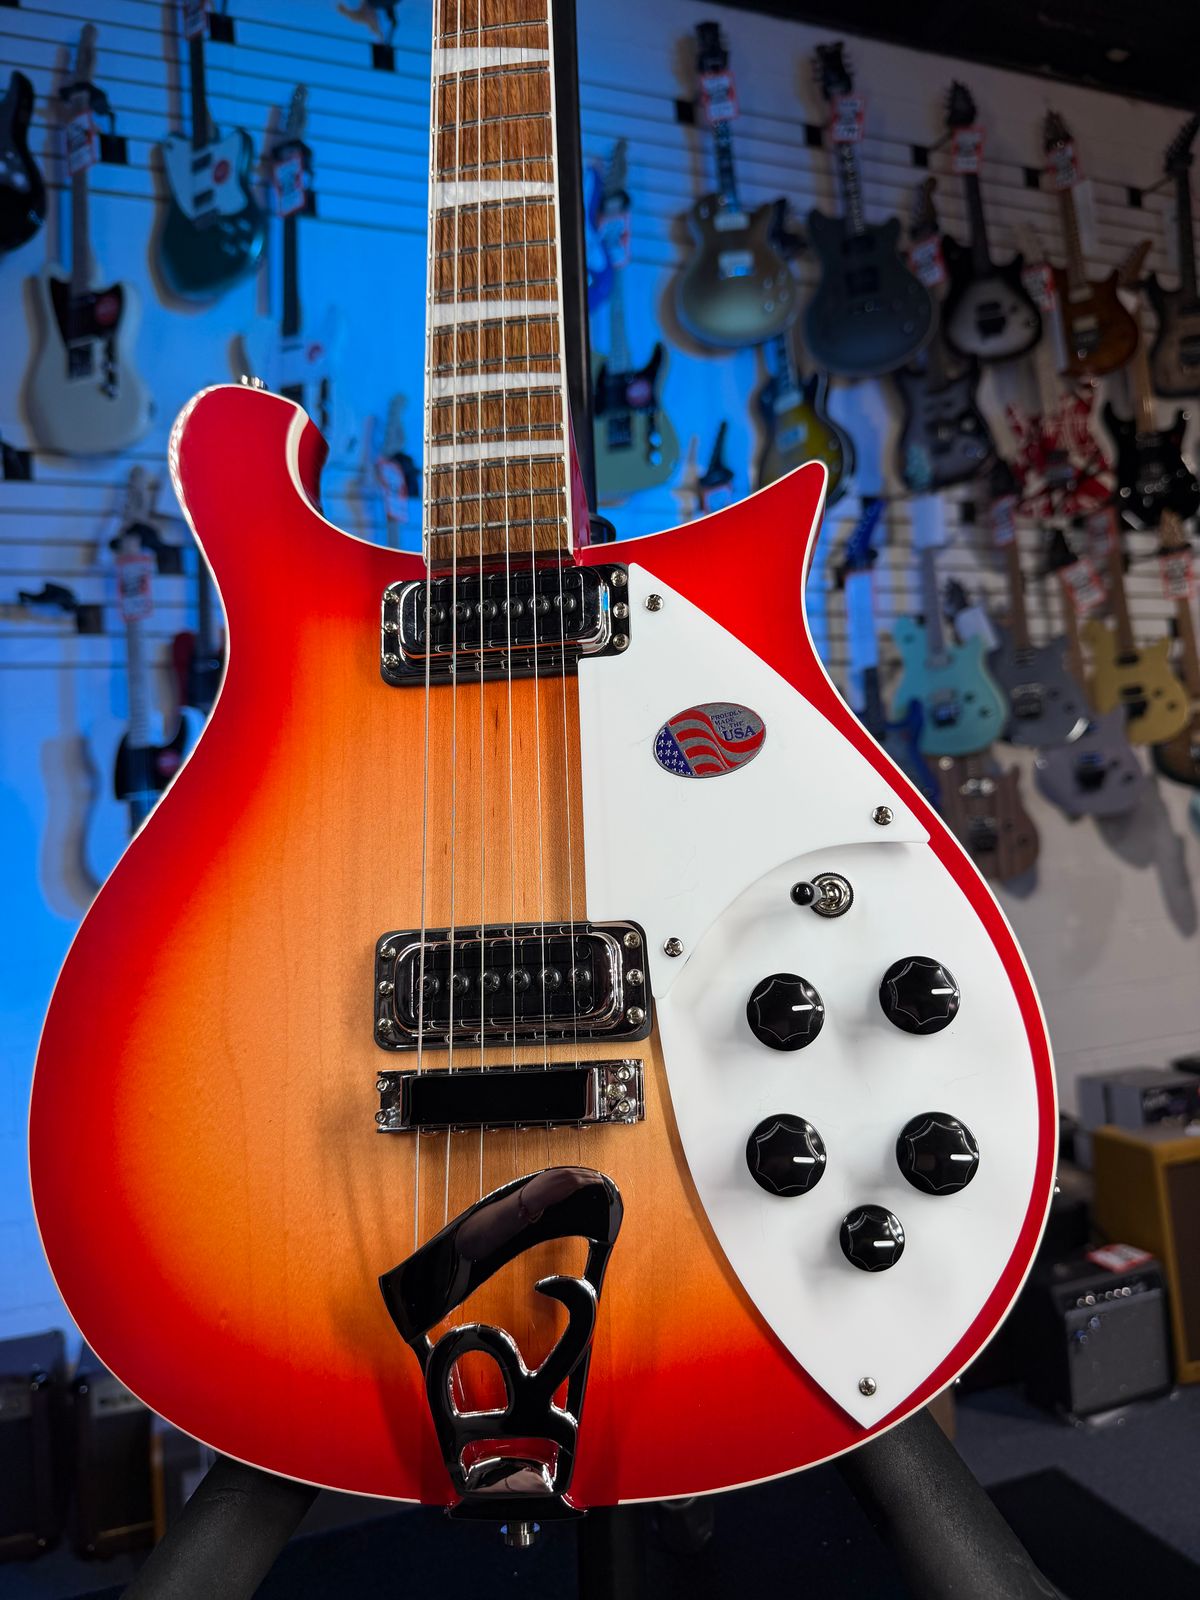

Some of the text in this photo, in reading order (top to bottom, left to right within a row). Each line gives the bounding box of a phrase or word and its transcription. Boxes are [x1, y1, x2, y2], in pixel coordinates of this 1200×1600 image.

[711, 709, 742, 720] PROUDLY
[714, 716, 734, 725] MADE
[722, 725, 757, 741] USA
